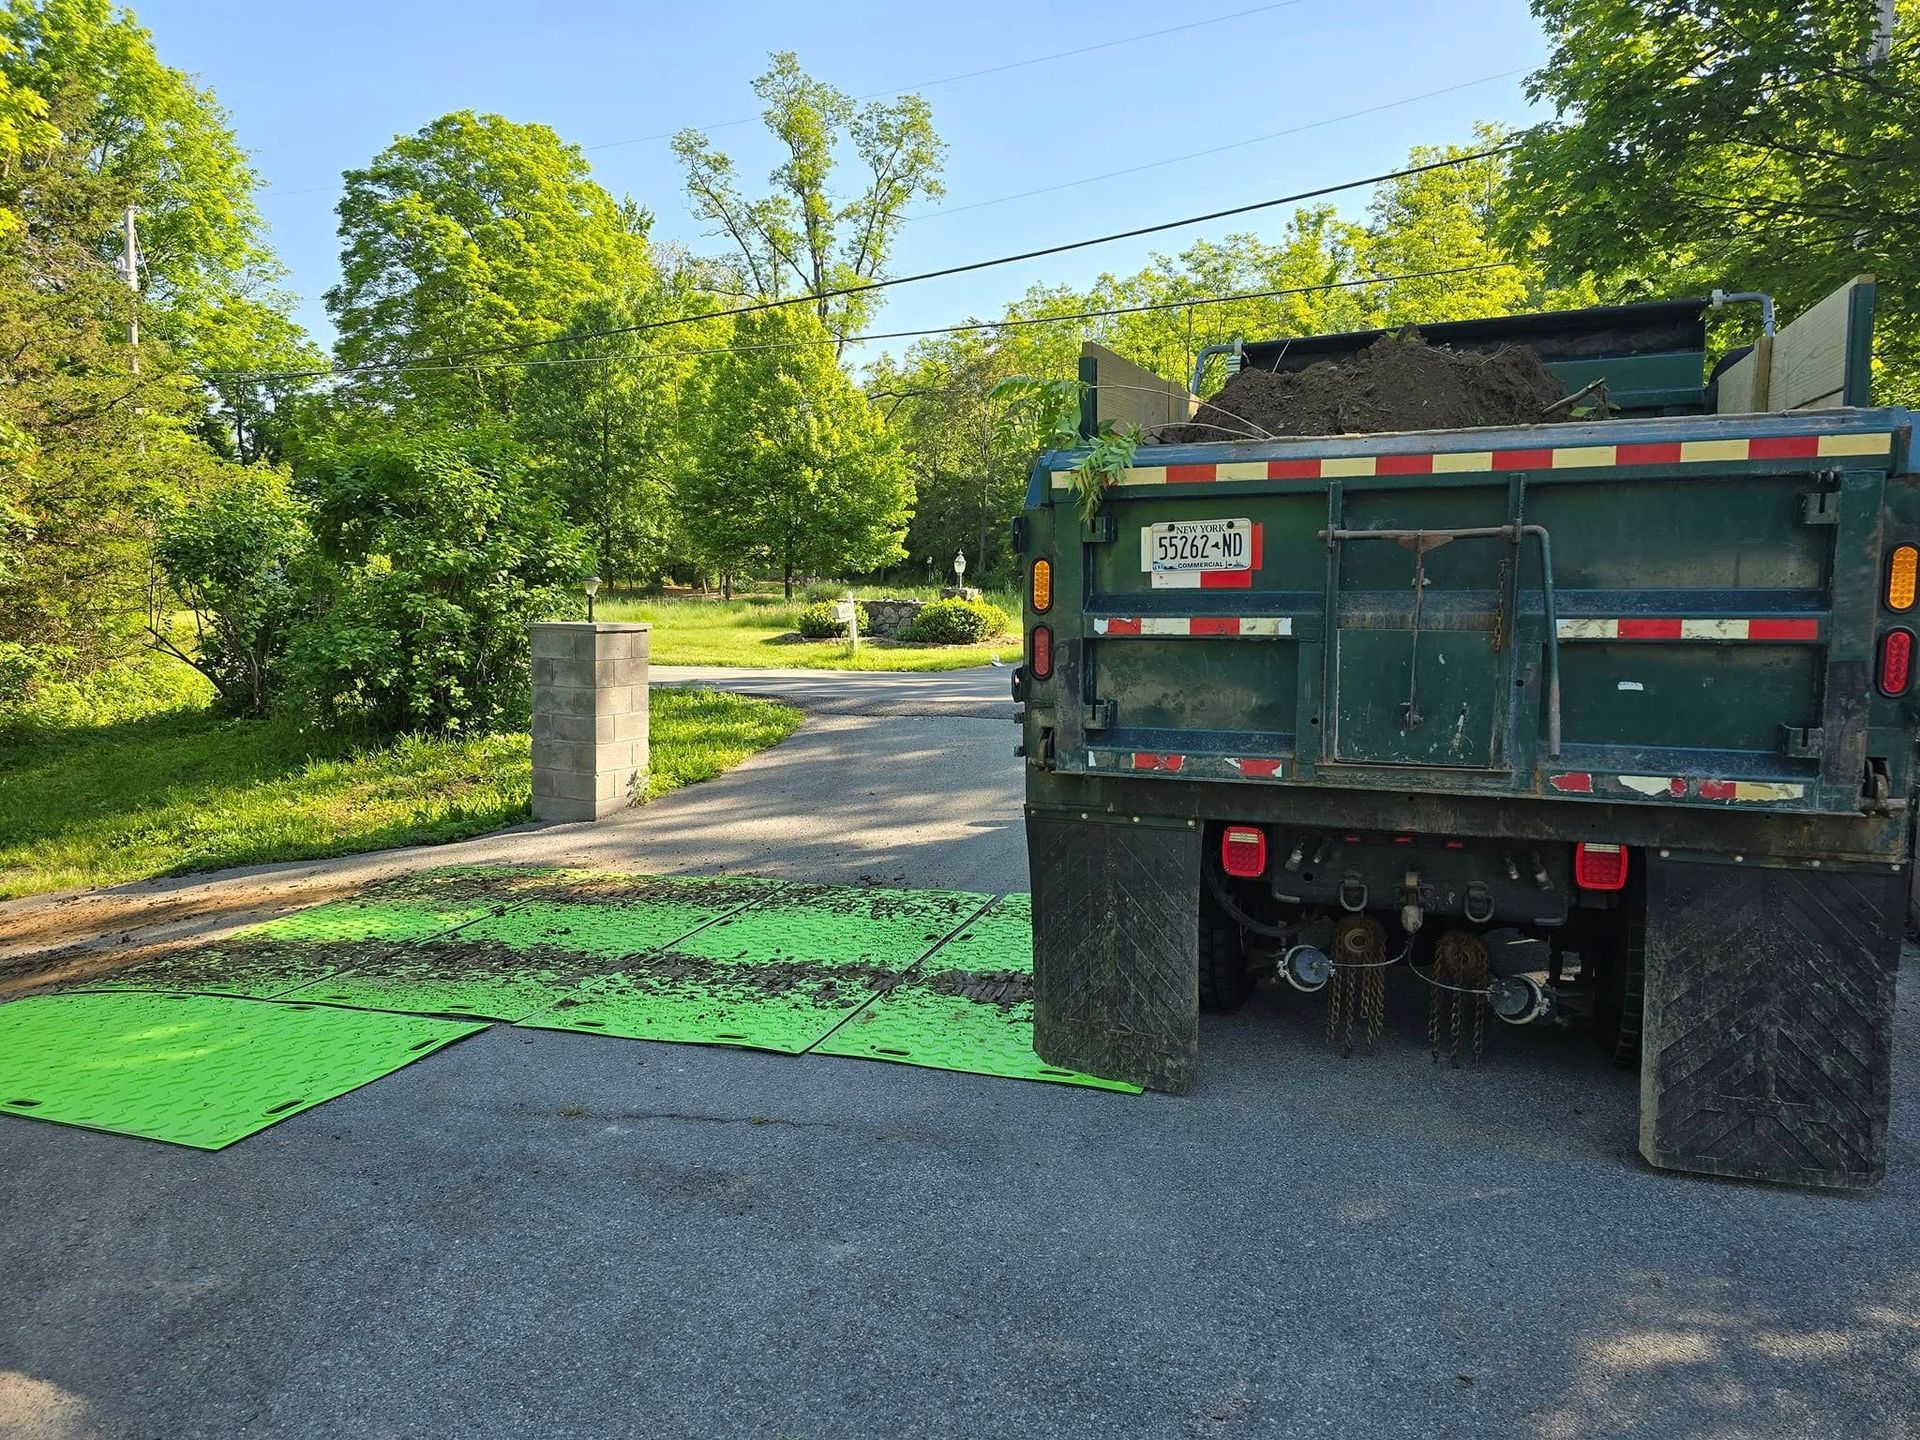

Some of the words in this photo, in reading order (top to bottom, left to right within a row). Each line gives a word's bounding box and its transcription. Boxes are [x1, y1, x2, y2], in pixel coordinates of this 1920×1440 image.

[1176, 526, 1198, 535] NEW
[1200, 524, 1226, 533] YORK
[1178, 561, 1223, 569] COMMERCIAL
